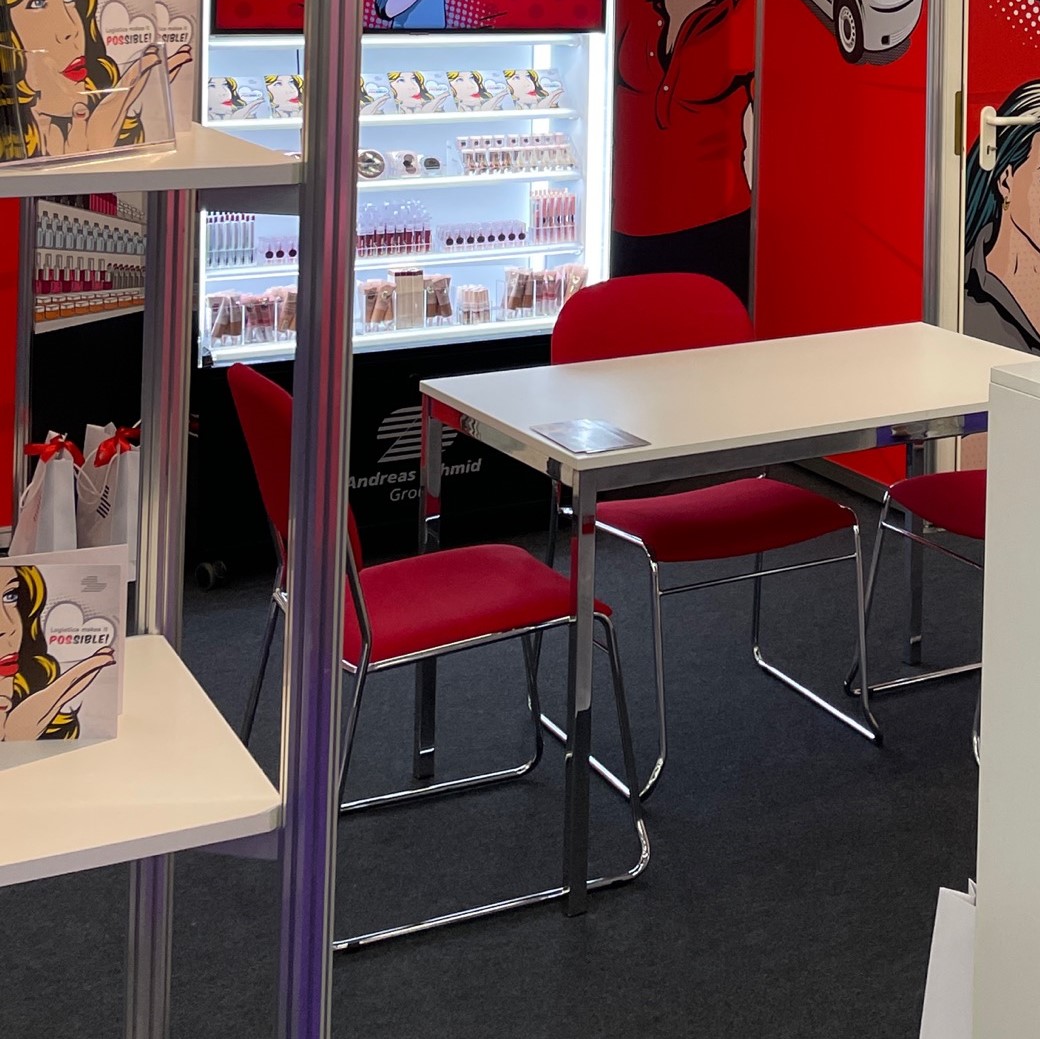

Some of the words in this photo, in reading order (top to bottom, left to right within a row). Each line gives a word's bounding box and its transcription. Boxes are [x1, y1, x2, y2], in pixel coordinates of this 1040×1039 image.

[106, 33, 152, 46] POSSIBLE!
[348, 470, 416, 488] Andreas
[441, 458, 482, 476] hmid
[49, 634, 110, 645] POSSIBLE!
